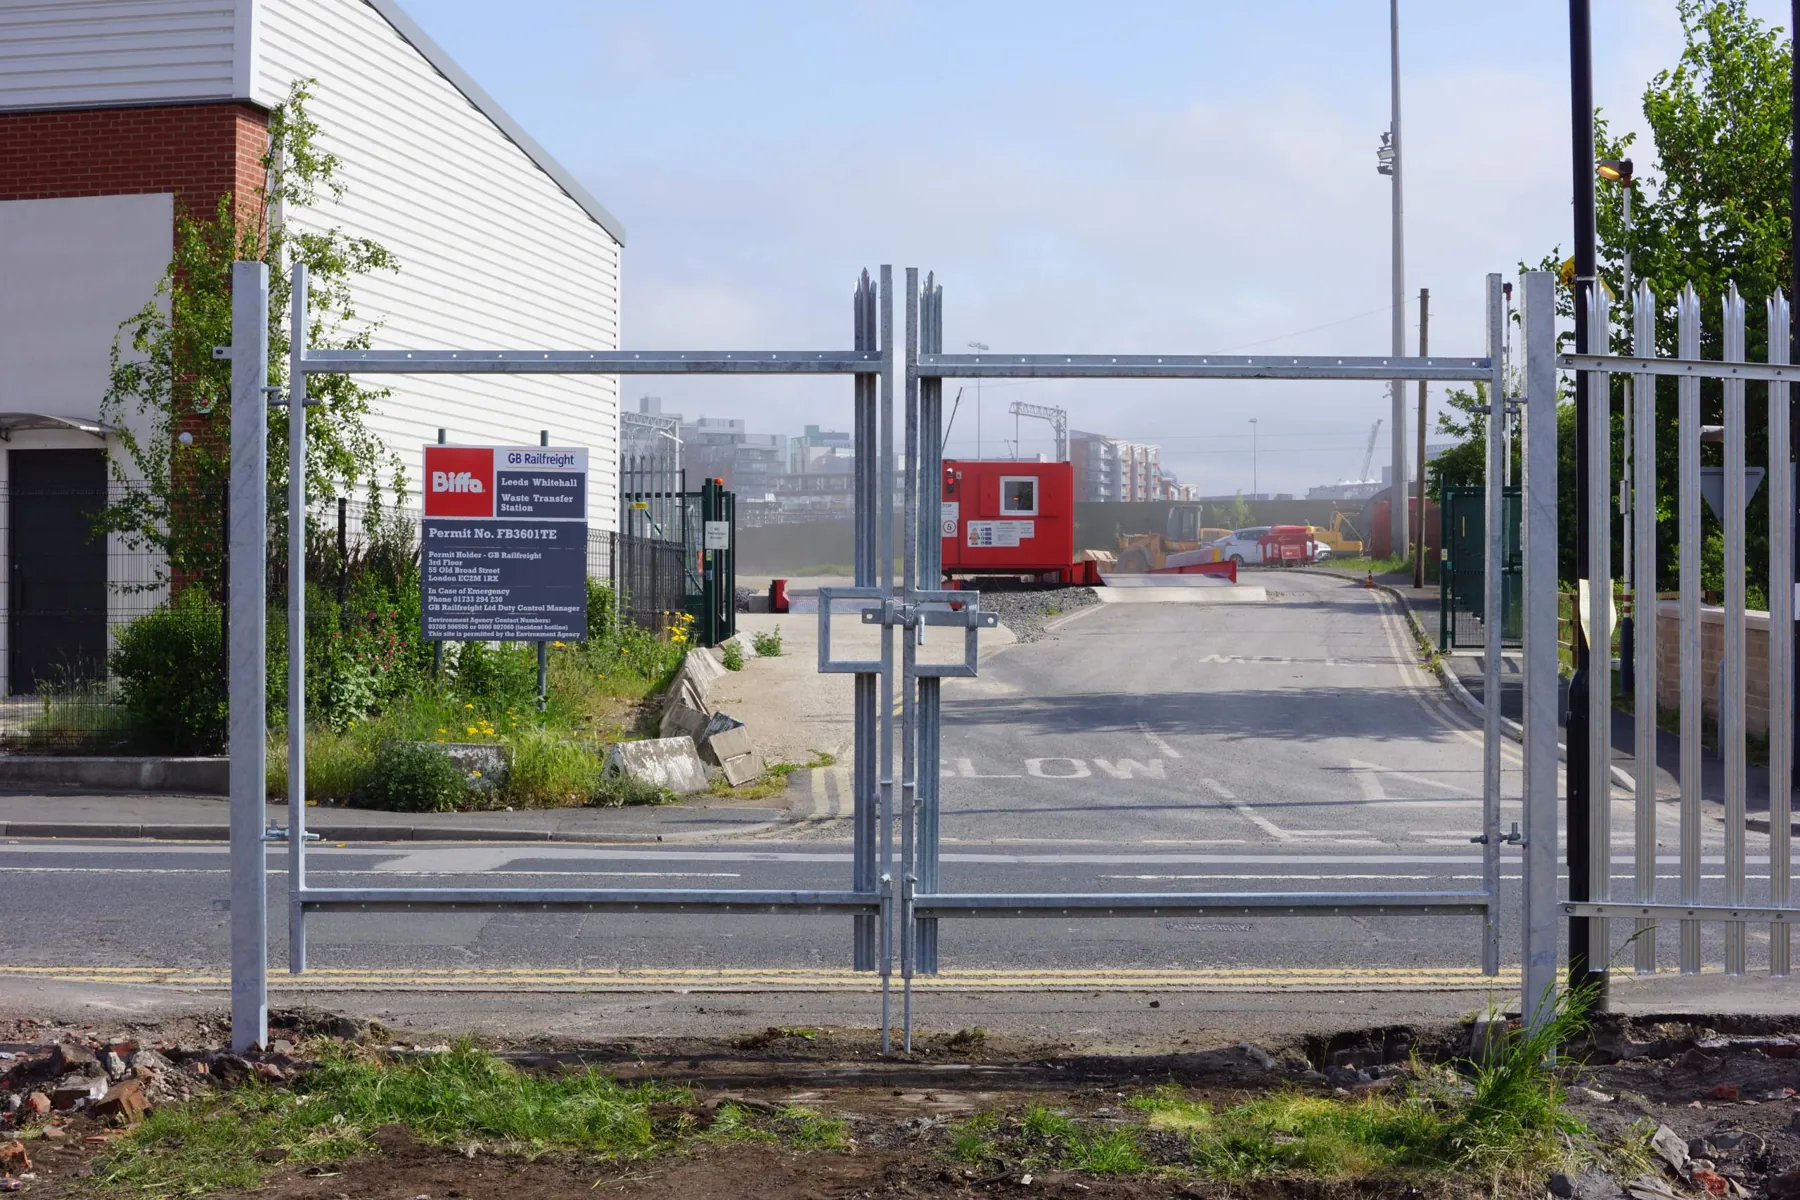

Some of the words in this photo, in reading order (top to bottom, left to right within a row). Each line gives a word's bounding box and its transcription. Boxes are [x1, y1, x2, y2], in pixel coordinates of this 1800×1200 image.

[508, 452, 522, 464] GB
[524, 453, 575, 467] Railfreight
[432, 471, 483, 493] Biffa
[501, 477, 529, 487] Leeds
[532, 478, 578, 487] Whitehall
[501, 493, 530, 503] Waste
[532, 494, 574, 503] Transfer
[501, 503, 534, 512] Station
[428, 527, 472, 539] Permit
[474, 529, 494, 539] No.
[496, 529, 558, 540] FB3601TE
[456, 551, 482, 559] Holder
[488, 551, 500, 559] GB
[501, 551, 542, 561] Railfreight
[428, 574, 457, 582] London
[467, 588, 510, 596] Emergency
[441, 604, 482, 613] Railfreight
[497, 605, 516, 613] Duty
[517, 604, 545, 612] Control
[546, 604, 580, 613] Manager
[470, 616, 494, 624] Agency
[520, 616, 551, 624] Numbers:
[463, 630, 494, 638] permitted
[495, 630, 504, 638] by
[557, 630, 580, 638] Agency
